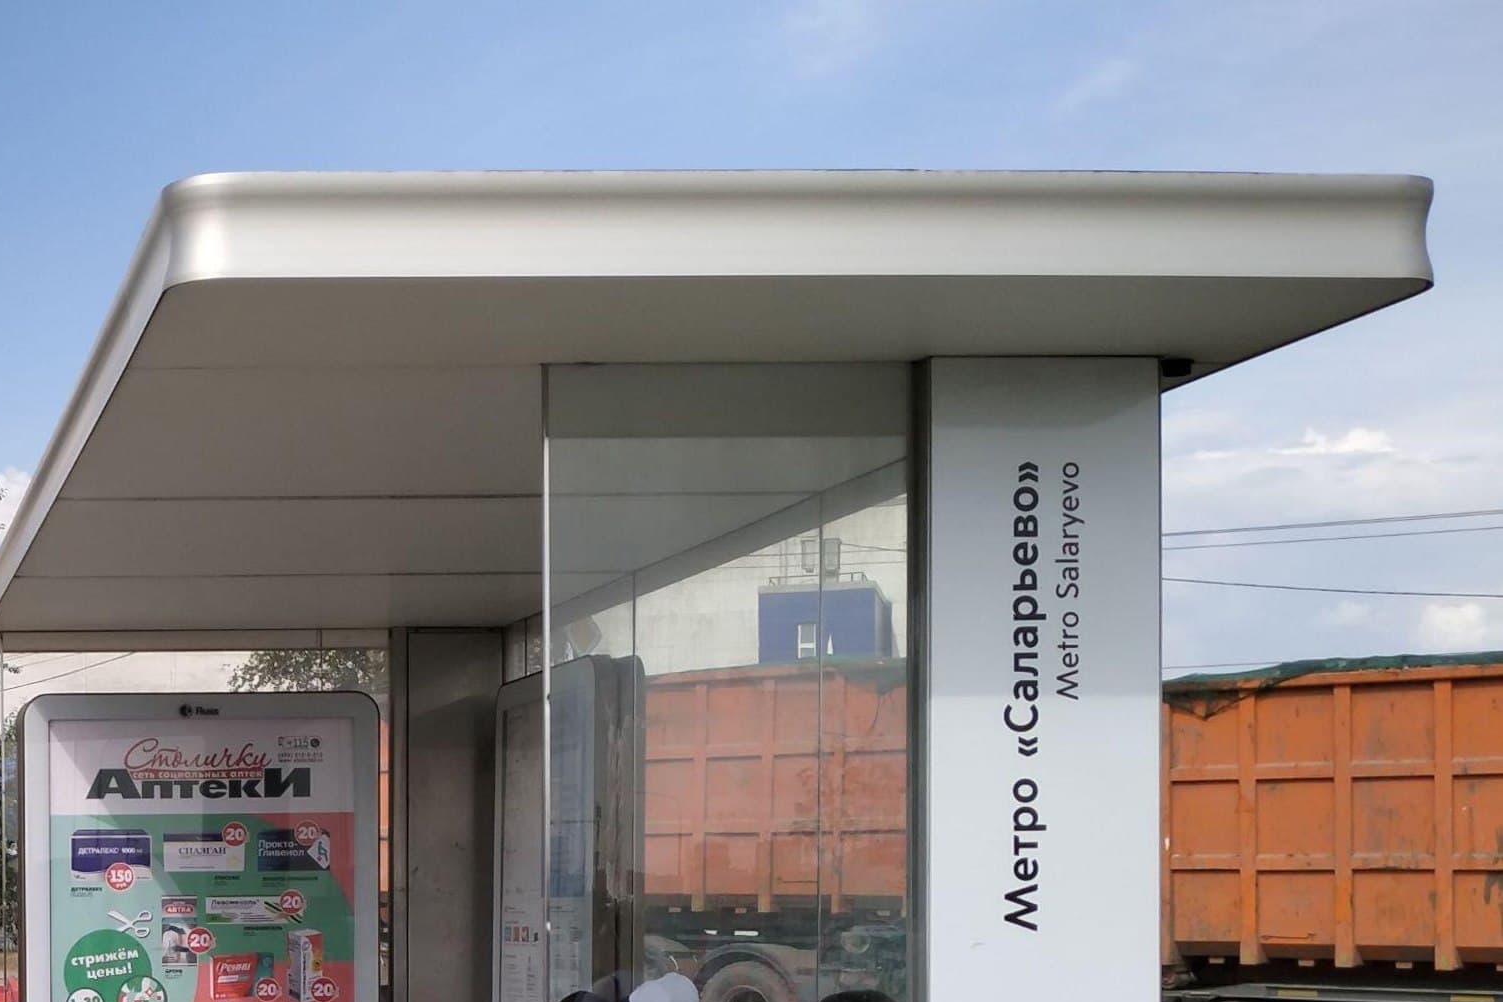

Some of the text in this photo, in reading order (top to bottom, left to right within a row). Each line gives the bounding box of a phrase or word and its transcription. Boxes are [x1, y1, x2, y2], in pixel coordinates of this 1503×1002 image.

[1055, 461, 1086, 700] Metro Salaryevo
[1003, 460, 1048, 932] Метро «Саларьево»
[124, 738, 273, 770] Столички
[86, 767, 311, 800] АптекИ
[158, 772, 228, 780] социальных
[230, 771, 263, 779] аптек
[178, 847, 227, 855] СПАЗГАН
[258, 839, 298, 849] Прокто-
[258, 849, 305, 857] Гливенол
[70, 947, 139, 968] стрижём
[86, 961, 133, 982] цены!
